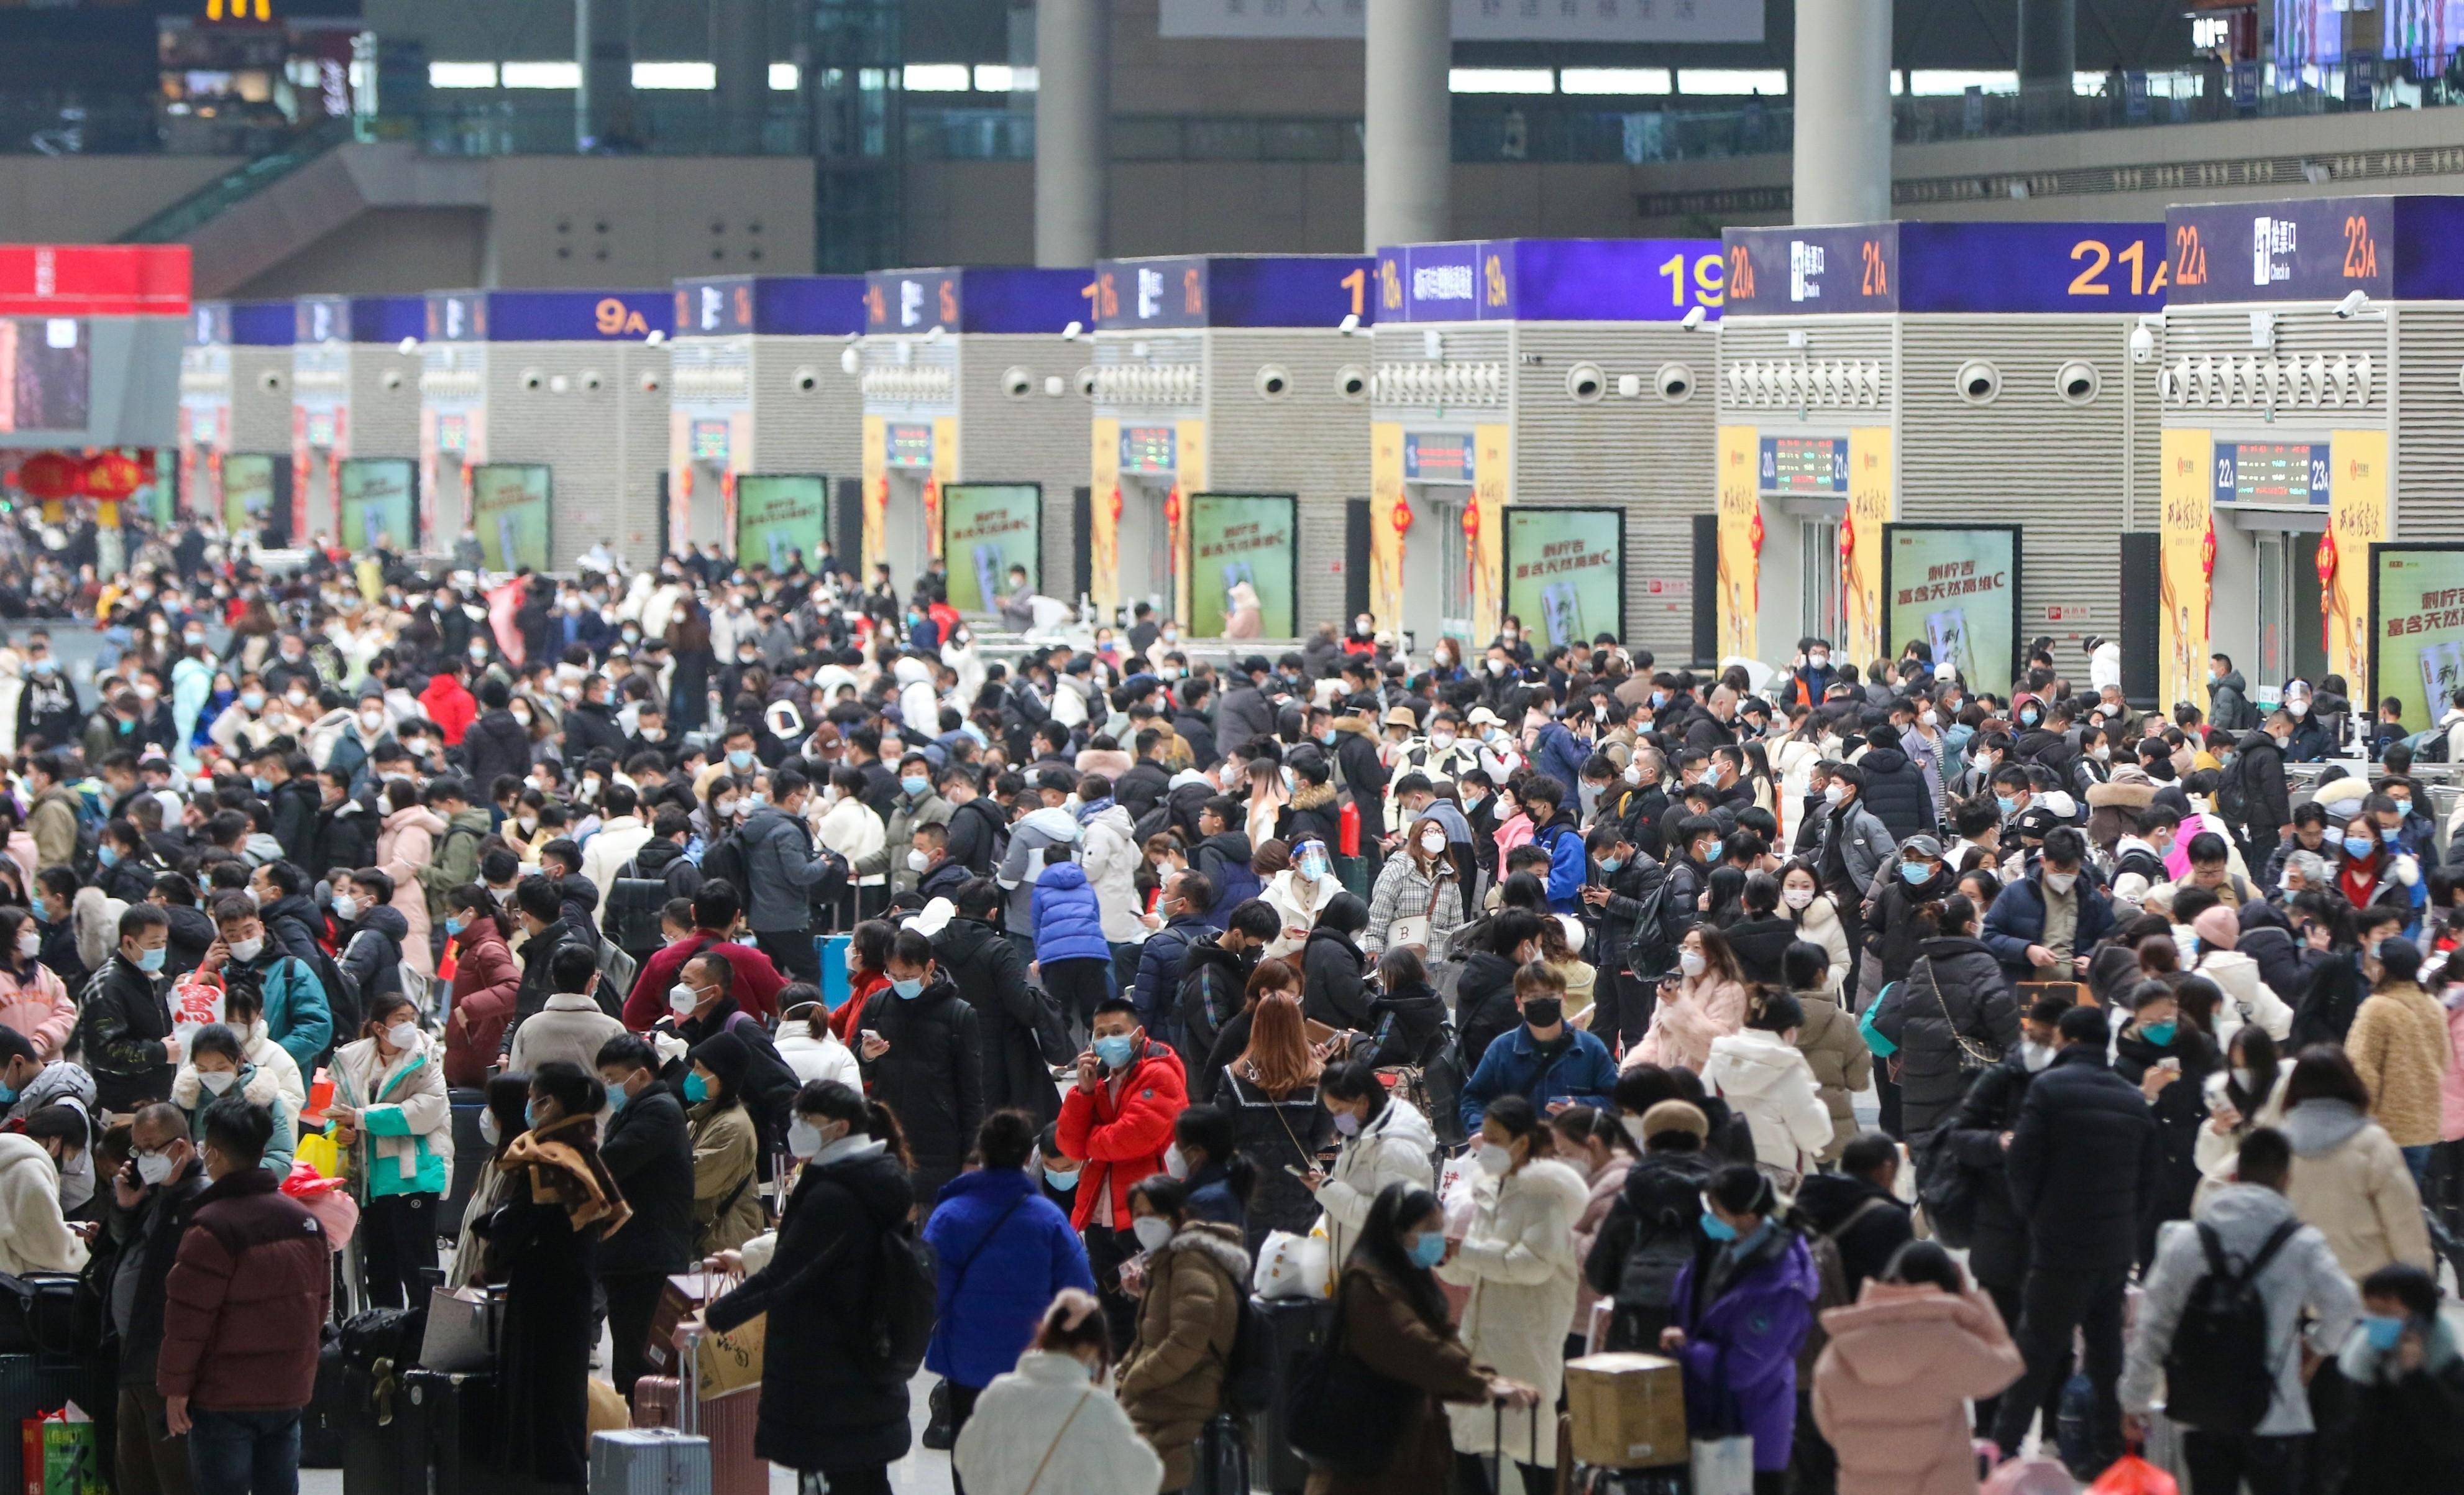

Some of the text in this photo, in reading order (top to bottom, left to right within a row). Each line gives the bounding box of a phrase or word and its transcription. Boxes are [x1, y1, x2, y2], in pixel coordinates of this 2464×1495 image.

[2271, 220, 2296, 255] 检票口
[2343, 216, 2376, 278] 23A
[1730, 246, 1754, 298] 20A
[1862, 242, 1887, 296] 21A
[2176, 226, 2207, 285] 22A
[2271, 262, 2290, 281] Check in
[1659, 254, 1723, 307] 19
[595, 298, 649, 334] 9A
[2219, 459, 2233, 489] 22A
[2312, 460, 2329, 490] 23A
[1928, 560, 1975, 582] 刺柠吉
[1898, 572, 2005, 605] 富含天然高维C
[2422, 587, 2464, 610] 刺柠
[2388, 607, 2464, 637] 富含天然
